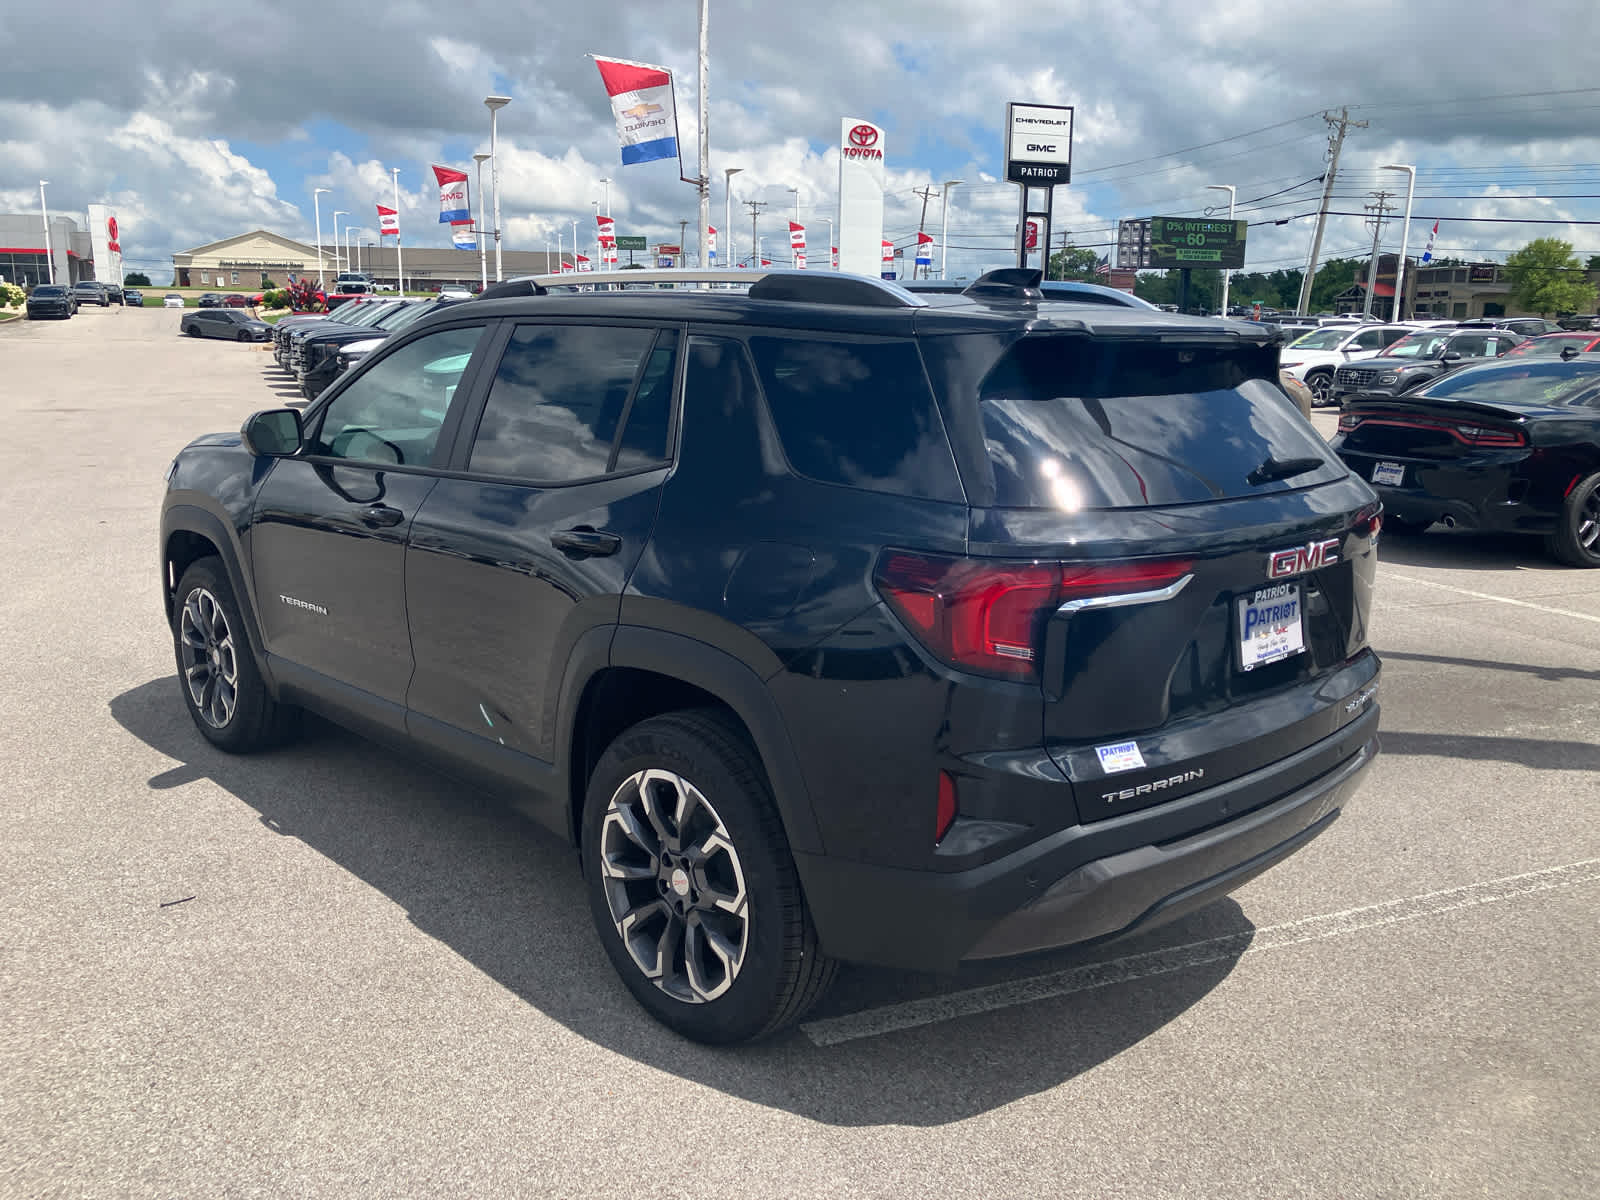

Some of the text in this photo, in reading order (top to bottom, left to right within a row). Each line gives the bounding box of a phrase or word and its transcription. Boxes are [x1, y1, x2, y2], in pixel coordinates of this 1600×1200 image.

[1015, 117, 1068, 126] CHEVROLET
[843, 147, 882, 159] TOYOTA
[1026, 143, 1056, 153] GMC
[1021, 167, 1058, 177] PATRIOT
[1166, 222, 1233, 233] 0% INTEREST
[1186, 233, 1206, 246] 60
[1267, 537, 1339, 579] GMC
[1255, 583, 1290, 604] PATRIOT
[280, 594, 328, 616] TERRAIN
[1244, 600, 1297, 641] PATRIOT
[1100, 743, 1135, 761] PATRIOT
[1102, 768, 1204, 803] TERRAIN
